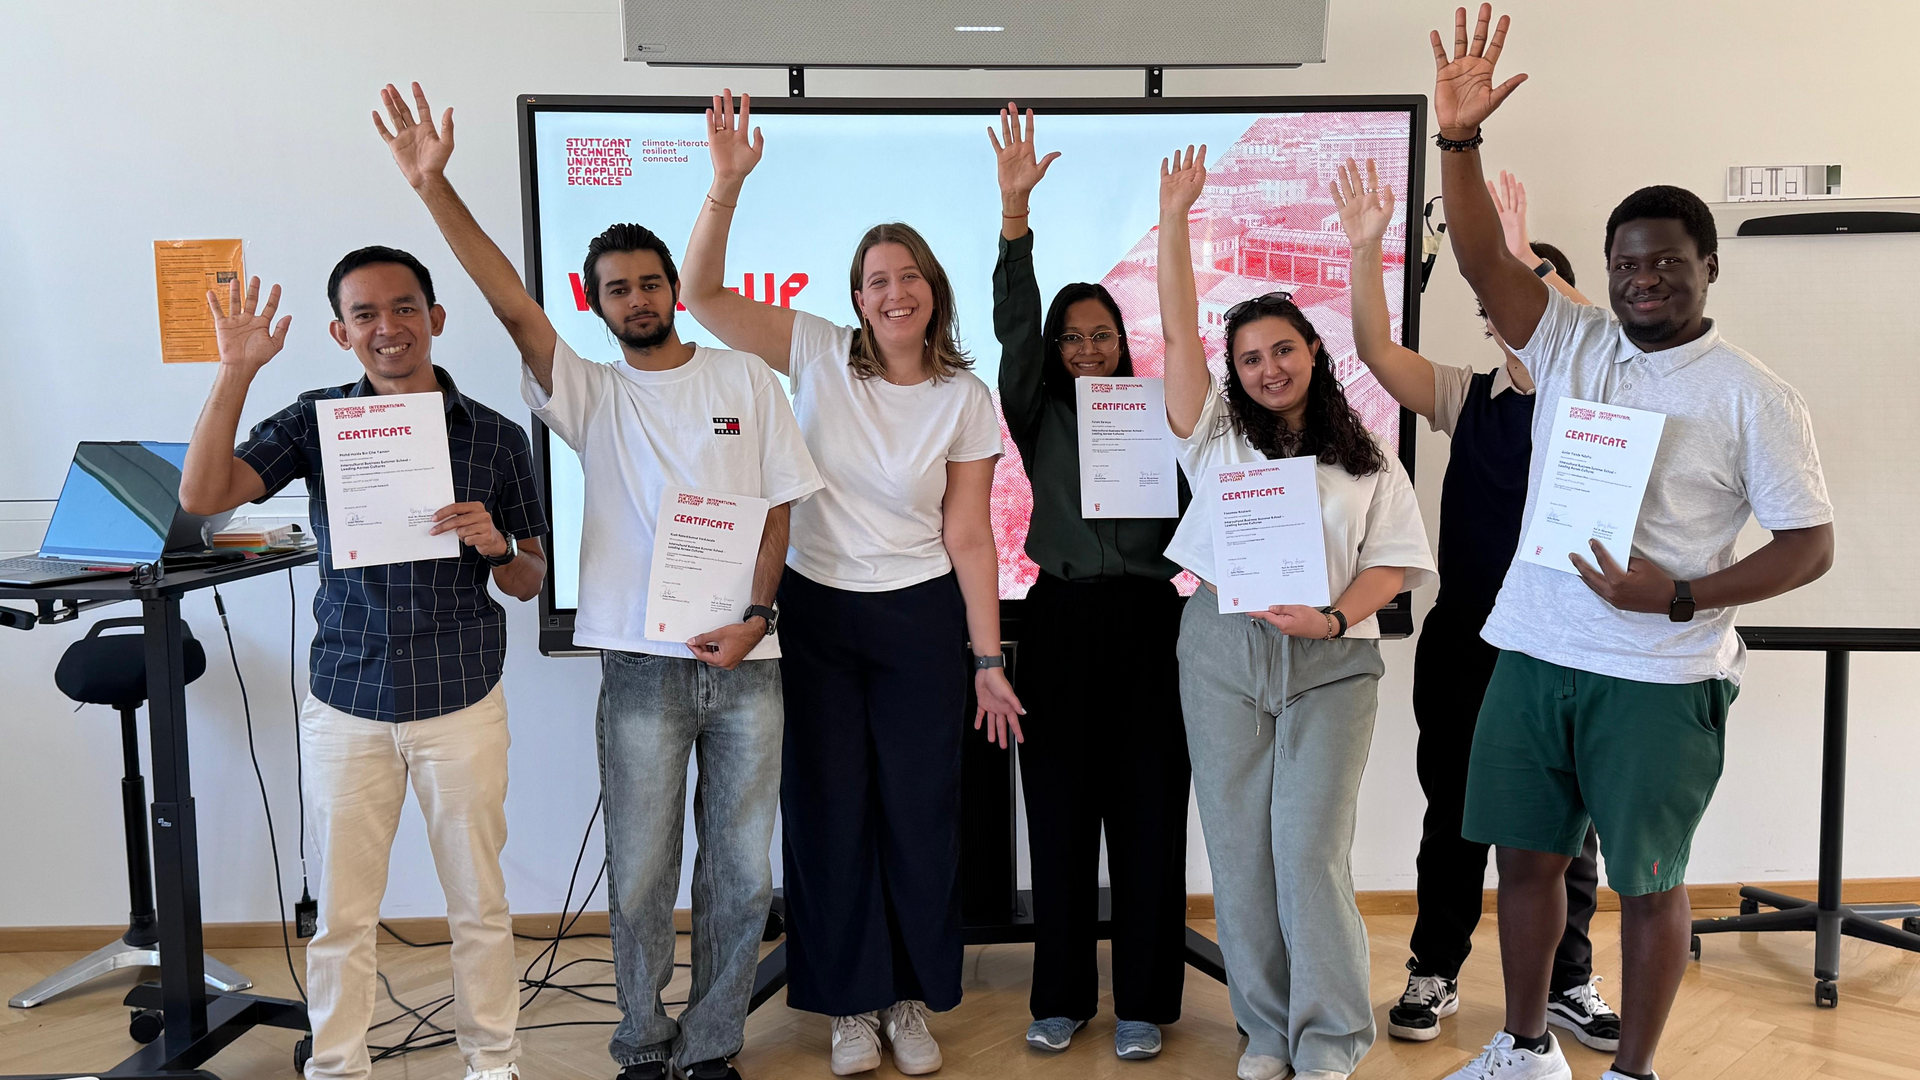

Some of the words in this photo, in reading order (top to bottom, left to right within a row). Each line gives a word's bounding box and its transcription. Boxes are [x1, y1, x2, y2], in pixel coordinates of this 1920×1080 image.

[566, 138, 632, 147] STUTTGART
[566, 148, 629, 157] TECHNICAL
[567, 158, 632, 166] UNIVERSITY
[568, 167, 582, 176] OF
[584, 167, 632, 176] APPLIED
[568, 177, 622, 186] SCIENCES
[1599, 411, 1630, 420] INTERNATIONAL
[338, 426, 411, 440] CERTIFICATE
[1565, 430, 1627, 448] CERTIFICATE
[1222, 487, 1285, 501] CERTIFICATE
[674, 514, 734, 530] CERTIFICATE
